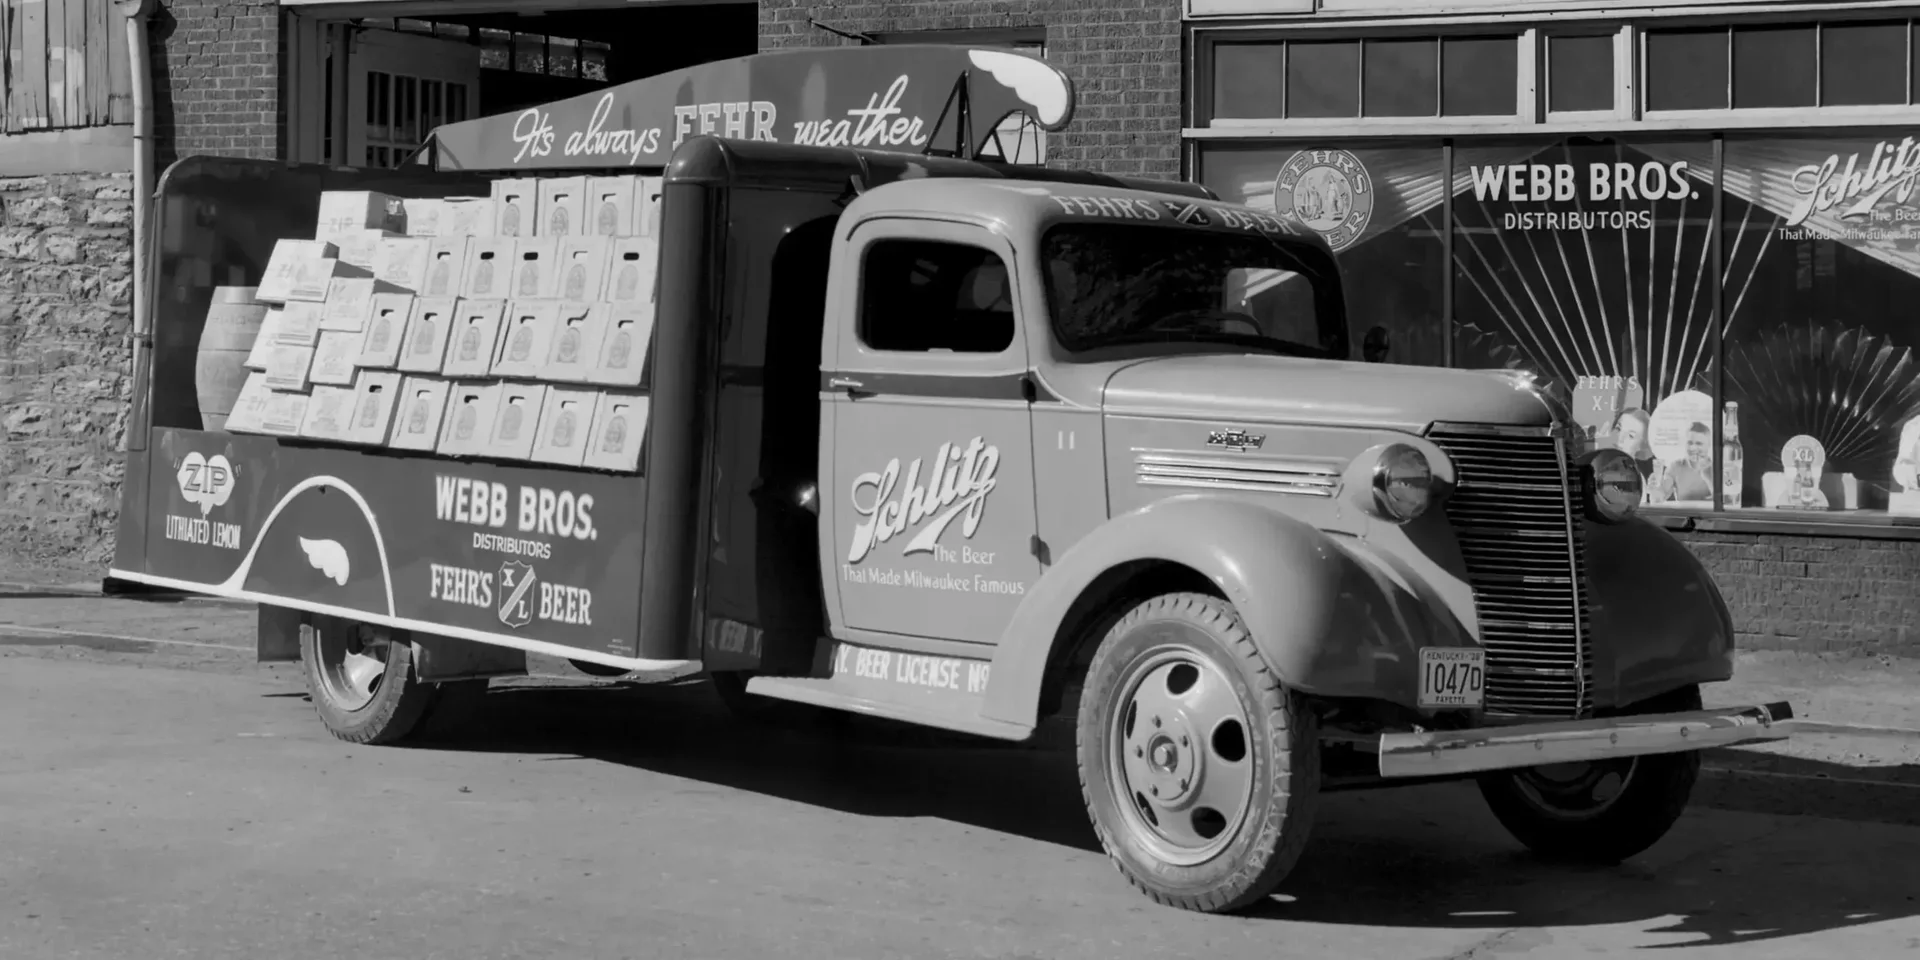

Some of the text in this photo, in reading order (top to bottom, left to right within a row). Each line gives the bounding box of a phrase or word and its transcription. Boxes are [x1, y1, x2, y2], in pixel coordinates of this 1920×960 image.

[565, 92, 660, 165] always
[673, 101, 778, 151] FEHR
[794, 74, 928, 147] weather
[1470, 160, 1700, 201] WEBB BROS.
[1211, 207, 1301, 236] BEER
[1504, 210, 1651, 230] DISTRIBUTORS
[1779, 227, 1803, 240] That
[1578, 375, 1638, 391] FEHR'S
[435, 475, 598, 541] WEBB BROS.
[849, 435, 1000, 564] Schlitz
[165, 514, 242, 550] LITHIATED LEMON
[472, 531, 552, 560] DISTRIBUTORS
[932, 543, 996, 565] The Beer
[430, 563, 494, 609] FEHR'S
[538, 581, 593, 626] BEER
[842, 563, 1025, 594] That Made Milwaukee Famous
[855, 648, 891, 681] BEER
[896, 653, 962, 690] LICENSE
[1425, 662, 1482, 695] 1047D
